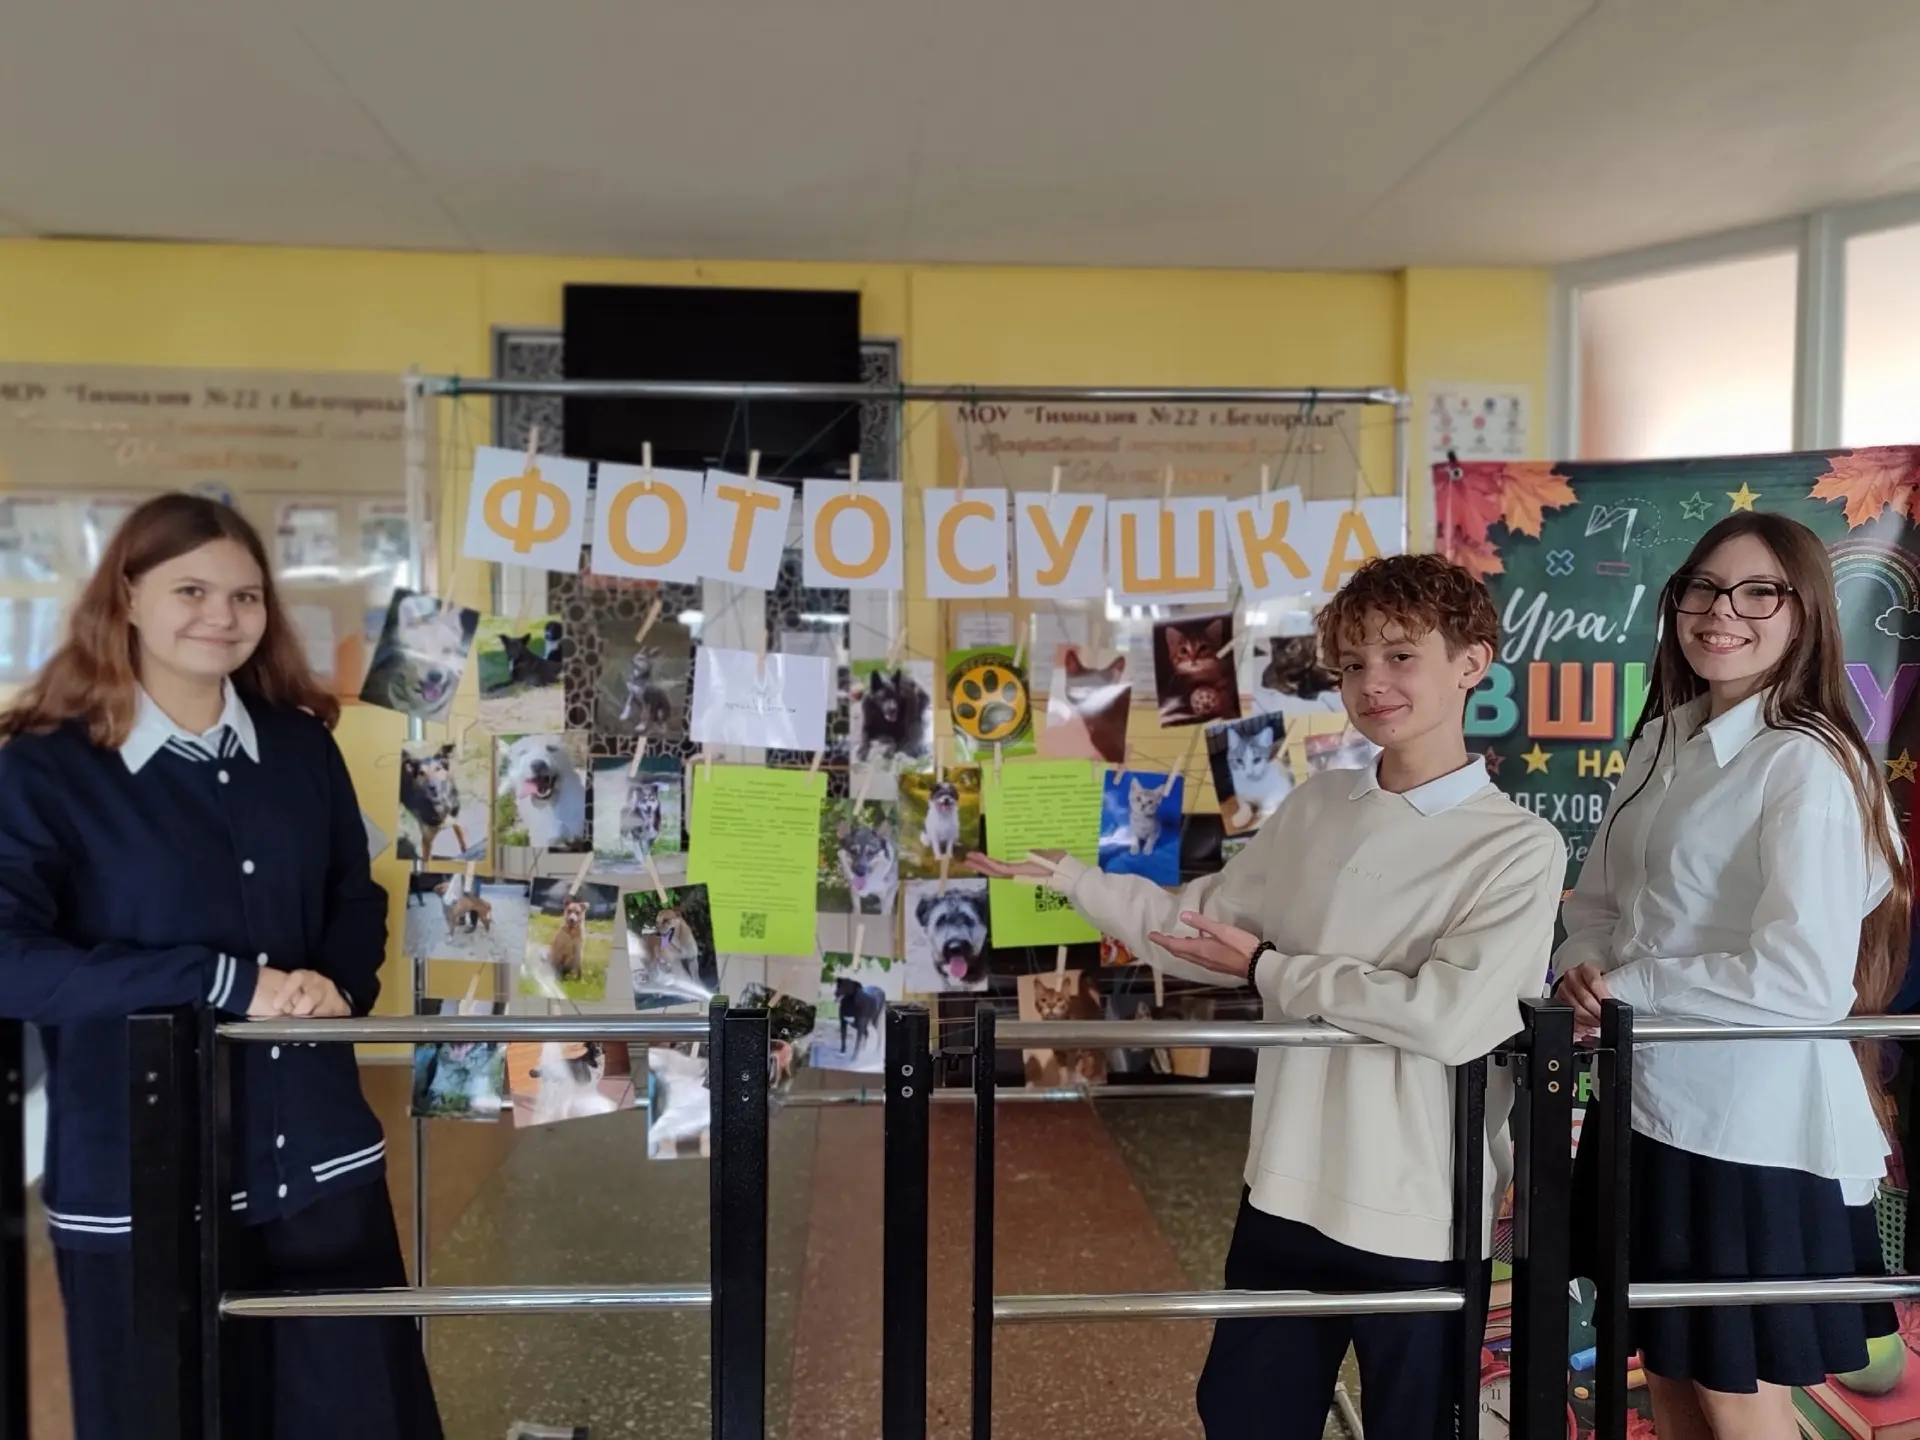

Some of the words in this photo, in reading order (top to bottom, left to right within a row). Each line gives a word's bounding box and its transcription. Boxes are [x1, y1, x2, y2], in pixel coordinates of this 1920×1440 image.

[957, 405, 1010, 424] МОУ
[1148, 406, 1199, 426] №22
[1501, 584, 1647, 664] Ура!
